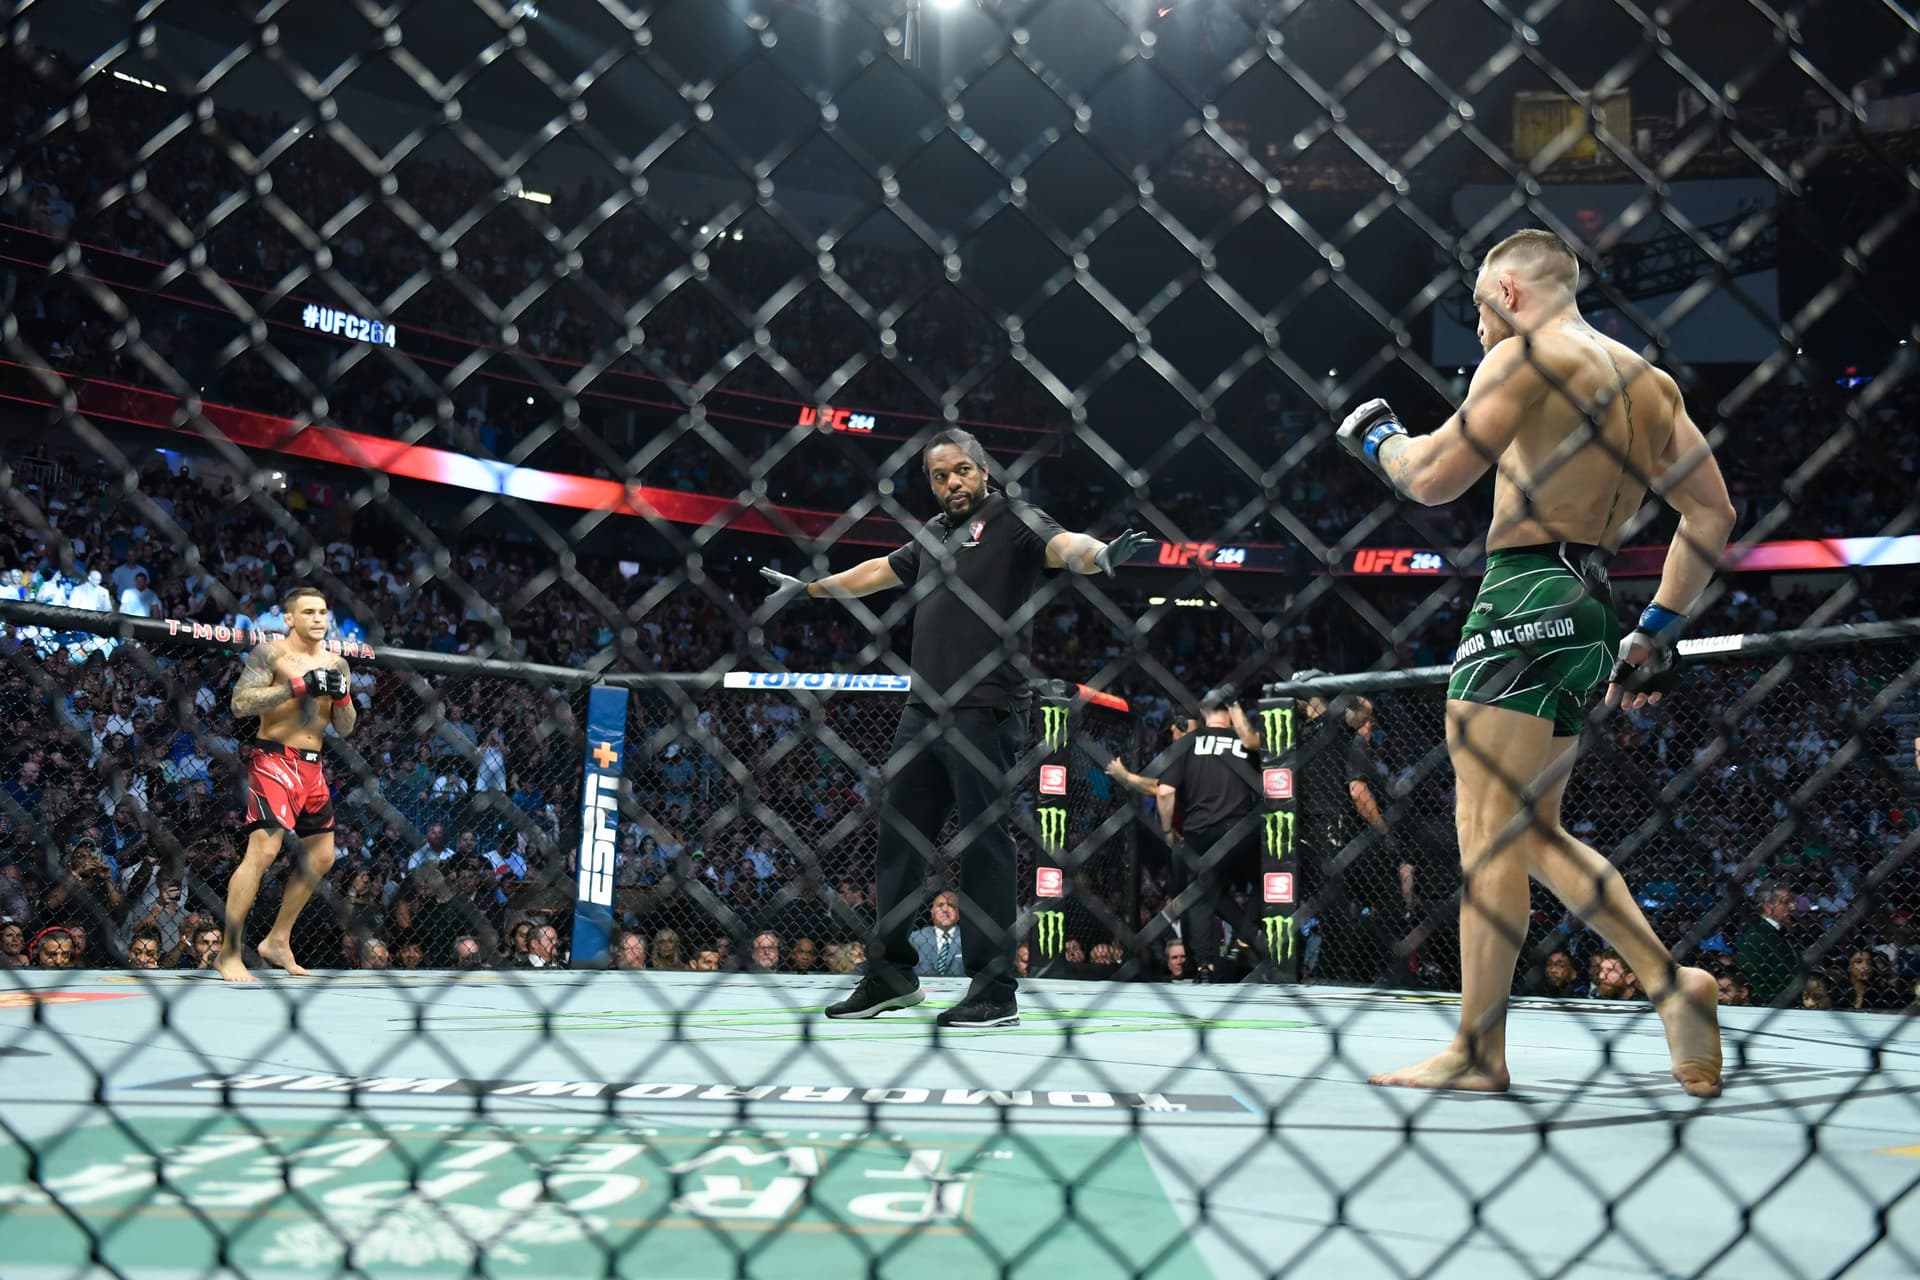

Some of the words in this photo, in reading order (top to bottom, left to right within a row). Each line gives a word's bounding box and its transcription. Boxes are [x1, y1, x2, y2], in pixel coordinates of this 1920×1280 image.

[302, 303, 396, 348] #UFC264
[798, 405, 851, 431] UFC
[847, 413, 876, 430] 264
[1158, 541, 1217, 567] UFC
[1215, 547, 1246, 564] 264
[1353, 549, 1414, 573] UFC
[1410, 552, 1442, 569] 264
[320, 638, 376, 660] ENA
[1453, 633, 1487, 666] ONOR
[748, 671, 827, 688] TOYO
[830, 673, 910, 689] TIRES
[1194, 734, 1249, 760] UFC
